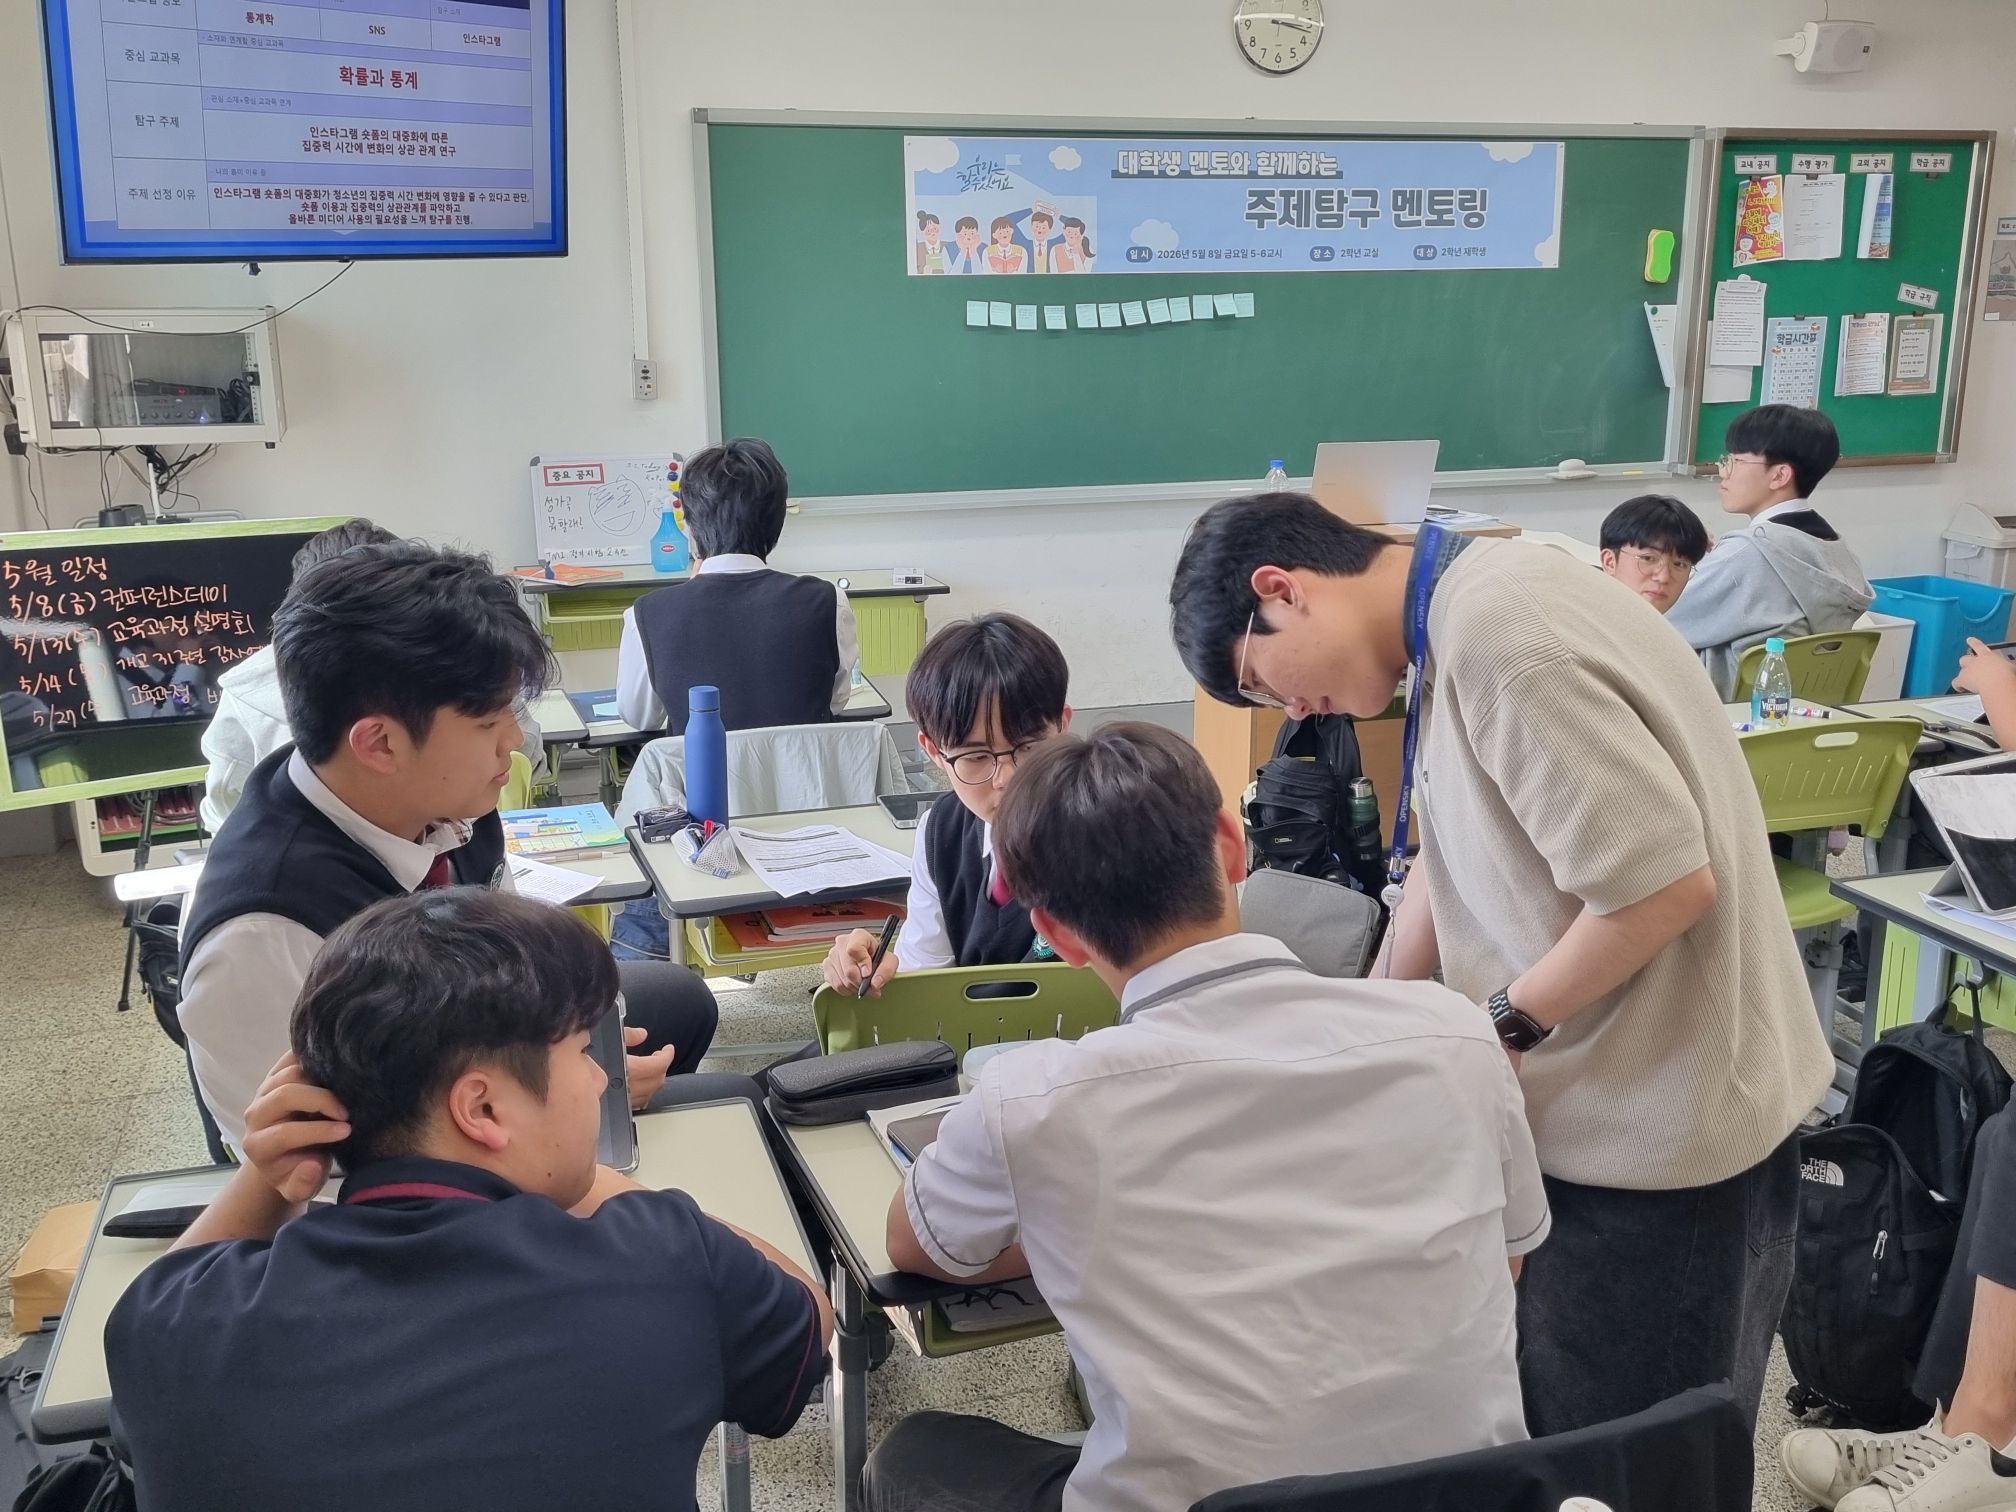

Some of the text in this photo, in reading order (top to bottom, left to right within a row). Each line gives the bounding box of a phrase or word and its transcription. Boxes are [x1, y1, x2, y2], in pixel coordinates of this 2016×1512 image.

[246, 11, 274, 25] 통계학
[368, 25, 386, 35] SNS
[1244, 19, 1252, 30] 9
[462, 33, 501, 46] 인스타그램
[1249, 36, 1256, 47] 8
[1299, 35, 1307, 46] 4
[125, 49, 180, 64] 중심 교과목
[1260, 48, 1267, 59] 7
[1274, 52, 1282, 63] 6
[1289, 48, 1296, 58] 5
[339, 65, 418, 89] 확률과 통계
[135, 114, 179, 128] 탐구 주제
[310, 126, 448, 143] 인스타그램 숏폼의 대중화에 따른
[302, 140, 456, 157] 집중력 시간에 변화의 상관 관계 연구
[1117, 149, 1339, 177] 대학생 멘토와 함께하는
[1740, 160, 1770, 170] 교내 공지
[1797, 160, 1828, 170] 수행 평가
[1856, 159, 1886, 168] 교외 공지
[1916, 159, 1945, 168] 학급 공지
[128, 188, 196, 200] 주제 선정 이유
[214, 187, 261, 199] 인스타그램
[264, 188, 292, 200] 숏폼의
[295, 189, 330, 200] 대중화가
[333, 189, 367, 200] 청소년의
[369, 190, 395, 201] 집중력
[397, 191, 414, 201] 시간
[416, 191, 440, 201] 변화에
[442, 191, 466, 202] 영향을
[468, 192, 476, 202] 줄
[479, 192, 486, 202] 수
[488, 193, 511, 202] 있다고
[301, 202, 461, 213] 숏폼 이용과 집중력의 상관관계를 파악하고
[1245, 188, 1489, 230] 주제탐구 멘토링
[289, 214, 473, 225] 올바른 미디어 사용의 필요성을 느껴 탐구를 진행.
[1157, 249, 1190, 259] 2026년
[1192, 249, 1206, 259] 5월
[1208, 249, 1222, 259] 8일
[1224, 248, 1248, 259] 금요일
[1250, 248, 1283, 259] 5-6교시
[1340, 249, 1361, 258] 2학년
[1363, 248, 1379, 258] 교실
[1441, 247, 1461, 257] 2학년
[1463, 247, 1487, 257] 재학생
[1905, 289, 1932, 302] 학급 규칙
[1776, 333, 1817, 346] 학급시간표
[552, 469, 594, 481] 중요 공지
[2, 556, 107, 589] 5월 일정
[9, 584, 228, 626] 5/8(금) 컨퍼런스데이
[1416, 587, 1426, 629] OPENSKY
[107, 615, 189, 642] 교육과정
[194, 610, 256, 636] 설명회
[116, 653, 150, 670] 개교
[128, 684, 190, 706] 교육과정
[1399, 785, 1411, 822] OPENSKY
[1809, 1157, 1827, 1168] THE
[1800, 1163, 1826, 1176] ORTH
[1801, 1171, 1826, 1183] FACE
